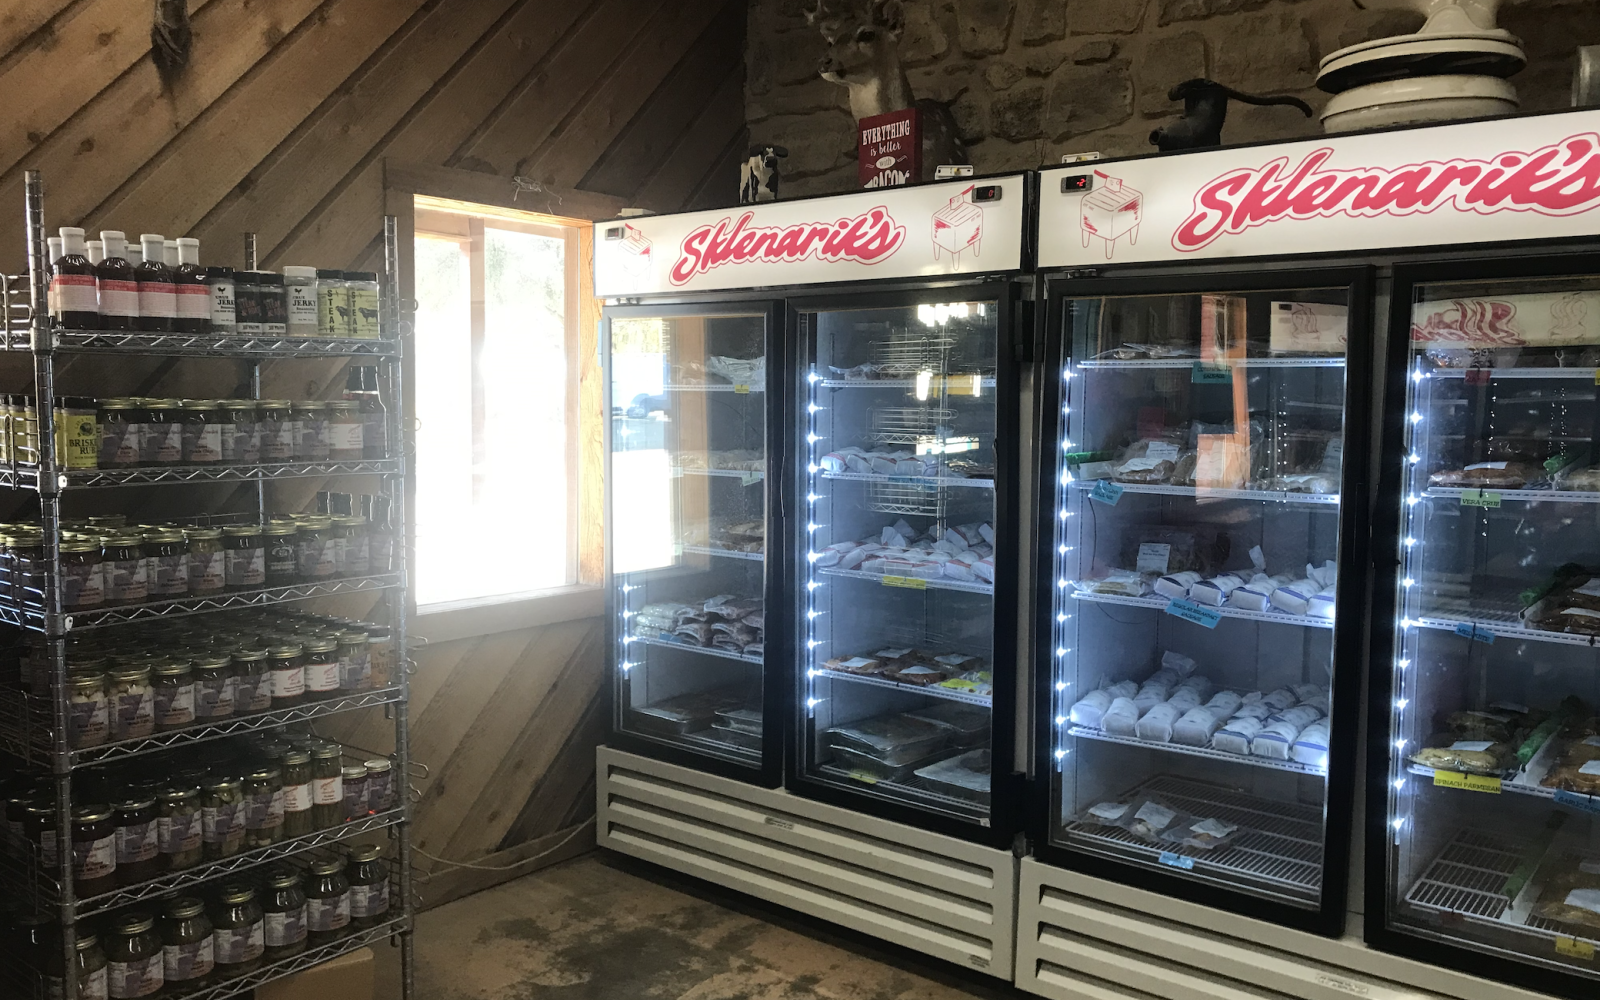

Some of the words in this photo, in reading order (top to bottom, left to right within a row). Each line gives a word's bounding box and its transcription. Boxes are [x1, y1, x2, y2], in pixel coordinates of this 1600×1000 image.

[862, 119, 911, 146] EVERYTHING
[870, 146, 877, 157] is
[878, 141, 901, 154] better
[879, 158, 892, 168] with
[1171, 132, 1600, 252] Sklenarik's
[670, 205, 906, 286] Sklenarik's
[292, 299, 317, 307] JERKY
[327, 289, 335, 333] STEAK
[79, 446, 96, 455] RUB
[1435, 779, 1463, 788] SPINACH
